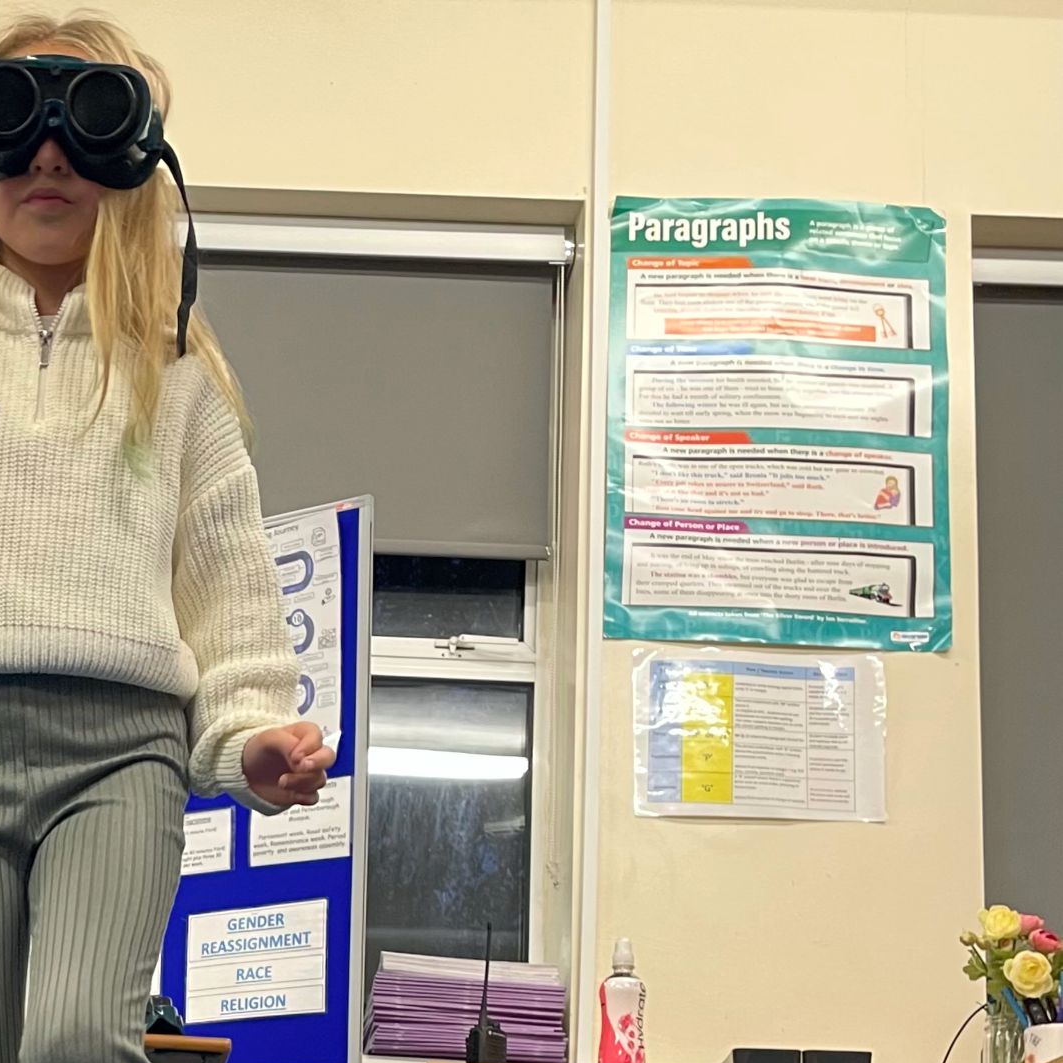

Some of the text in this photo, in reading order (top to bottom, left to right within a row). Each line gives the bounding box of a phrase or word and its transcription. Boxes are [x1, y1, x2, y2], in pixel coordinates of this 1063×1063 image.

[628, 211, 791, 247] Paragraphs
[632, 260, 664, 268] Change
[629, 432, 661, 441] Change
[675, 434, 710, 442] Speaker
[273, 524, 300, 537] Journey
[629, 519, 661, 528] Change
[663, 520, 672, 528] of
[675, 521, 703, 529] Person
[717, 523, 739, 531] Place
[800, 540, 826, 548] person
[227, 913, 284, 931] GENDER
[201, 931, 311, 955] REASSIGNMENT
[236, 966, 272, 981] RACE
[220, 995, 286, 1012] RELIGION
